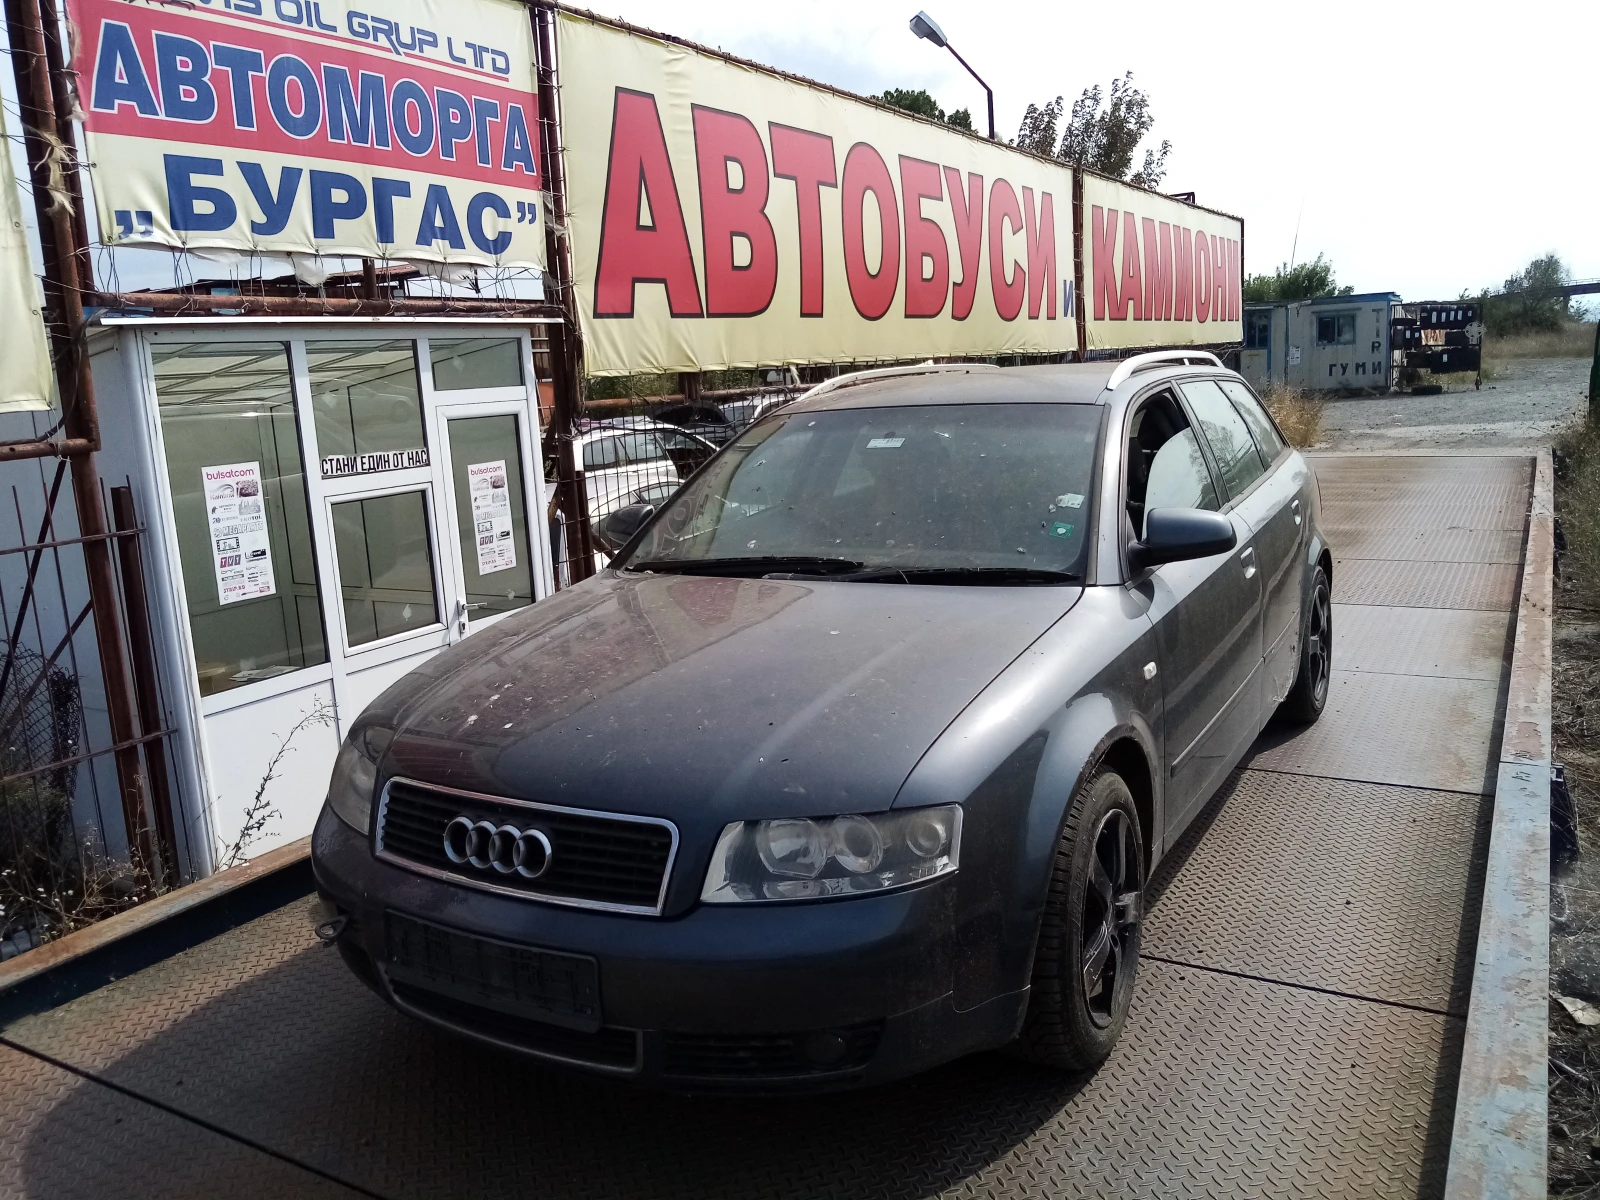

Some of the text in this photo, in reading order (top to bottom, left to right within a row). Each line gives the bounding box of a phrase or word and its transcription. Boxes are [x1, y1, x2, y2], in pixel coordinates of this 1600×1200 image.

[275, 0, 337, 33] OIL
[346, 10, 438, 56] GRUP
[447, 36, 510, 75] LTD
[91, 19, 537, 177] АВТОМОРГА
[593, 86, 1058, 322] АВТОБУСИ
[1091, 204, 1240, 323] КАМИОНИ
[1328, 361, 1382, 376] ГУМИ
[206, 468, 255, 480] bulsatcom
[321, 449, 427, 475] СТАНИ ЕДИН ОТ НАС
